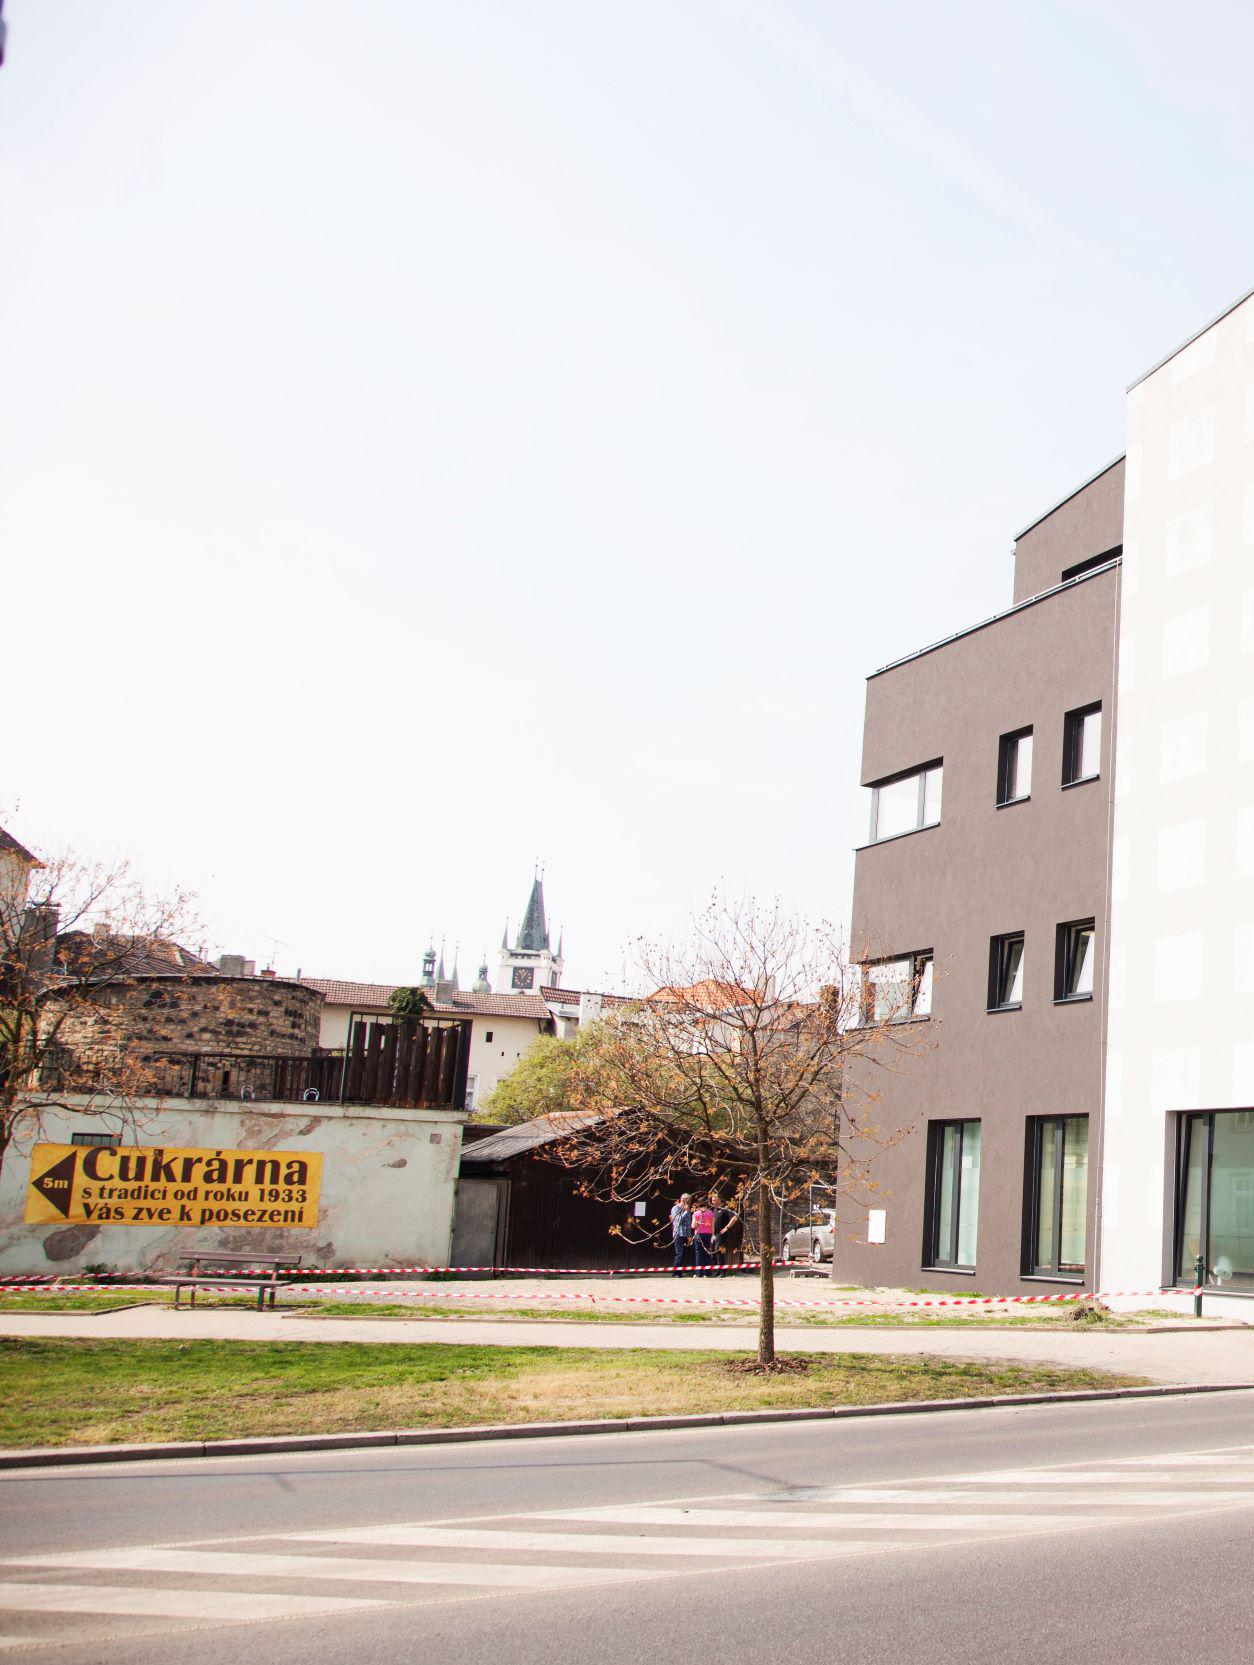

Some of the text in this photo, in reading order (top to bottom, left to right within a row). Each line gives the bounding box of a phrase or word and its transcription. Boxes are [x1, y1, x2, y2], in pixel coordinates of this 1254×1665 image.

[82, 1147, 308, 1186] Cukrárna
[43, 1177, 68, 1189] 5m
[82, 1187, 92, 1199] s
[173, 1187, 198, 1201] od
[204, 1187, 249, 1202] roku
[258, 1188, 307, 1203] 1933
[82, 1202, 125, 1220] Vás
[131, 1206, 172, 1221] zve
[179, 1204, 193, 1222] k
